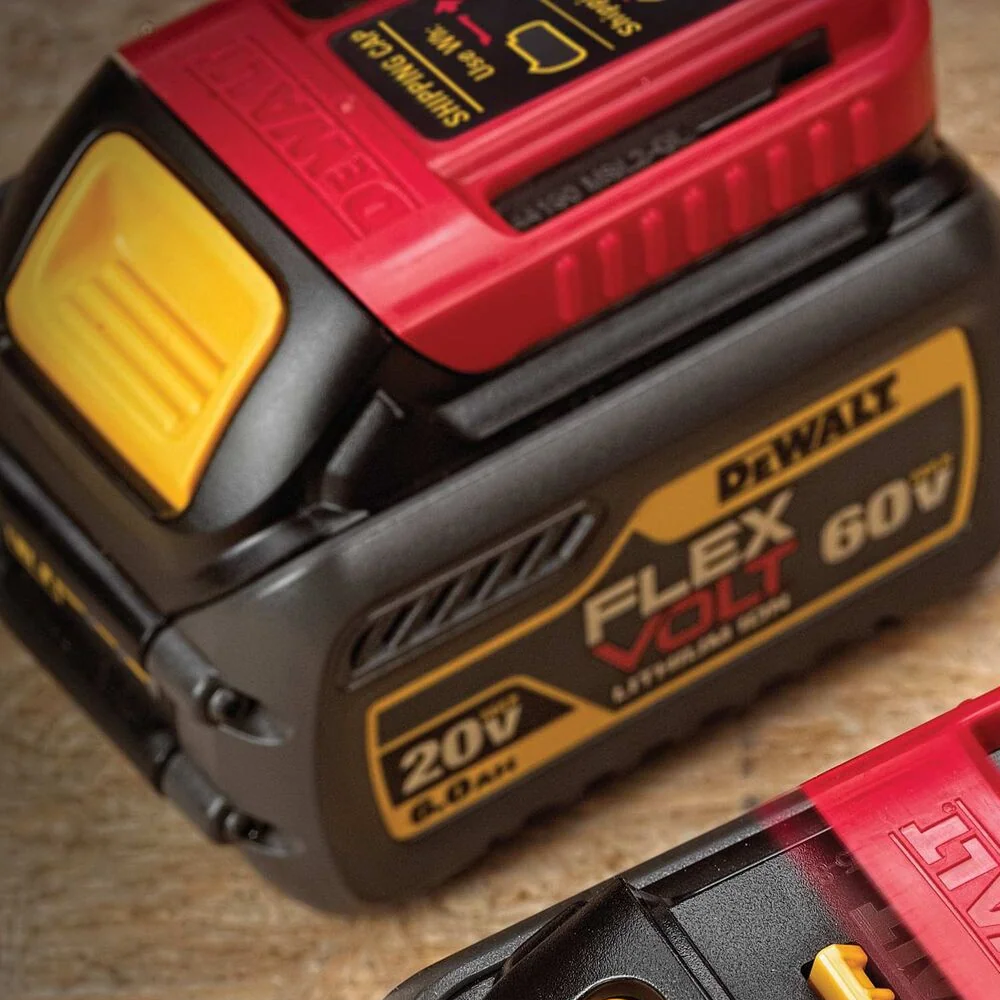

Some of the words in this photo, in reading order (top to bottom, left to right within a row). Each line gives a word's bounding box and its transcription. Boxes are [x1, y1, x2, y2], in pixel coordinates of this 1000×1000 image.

[350, 30, 393, 59] CAP
[380, 53, 471, 128] SHIPPING
[457, 49, 496, 82] Use
[717, 372, 898, 503] DEWALT
[583, 488, 796, 647] FLEX
[592, 538, 799, 674] VOLT
